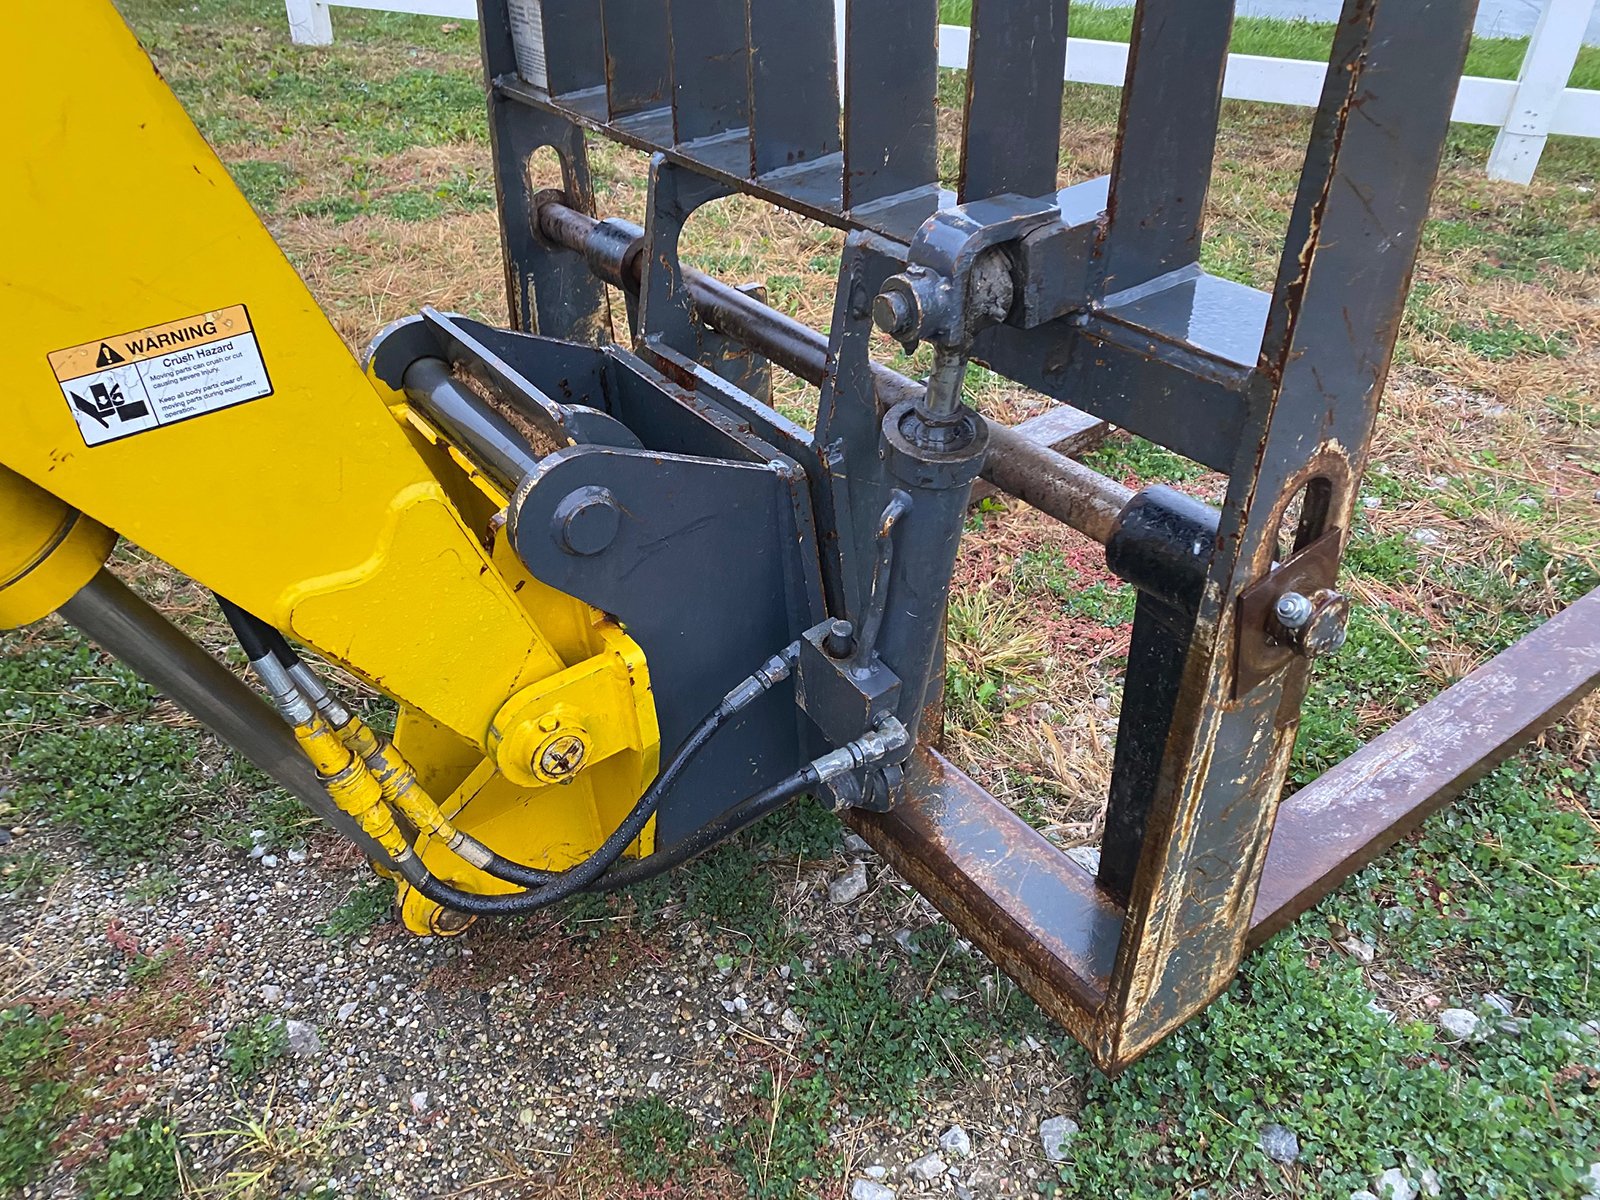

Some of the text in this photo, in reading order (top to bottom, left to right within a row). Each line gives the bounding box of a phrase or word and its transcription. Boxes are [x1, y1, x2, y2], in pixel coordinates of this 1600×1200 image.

[125, 321, 217, 355] WARNING
[163, 341, 234, 367] Crush Hazard
[150, 370, 174, 381] Moving
[176, 366, 192, 376] parts
[206, 357, 224, 366] crush
[153, 379, 179, 389] causing
[179, 373, 200, 382] severe
[159, 394, 176, 405] Keep
[177, 391, 185, 399] all
[186, 388, 201, 398] body
[203, 383, 219, 392] parts
[220, 378, 235, 387] clear
[162, 401, 186, 411] moving
[187, 396, 202, 405] parts
[204, 389, 224, 400] during
[225, 380, 257, 393] equipment
[164, 406, 196, 419] operation.
